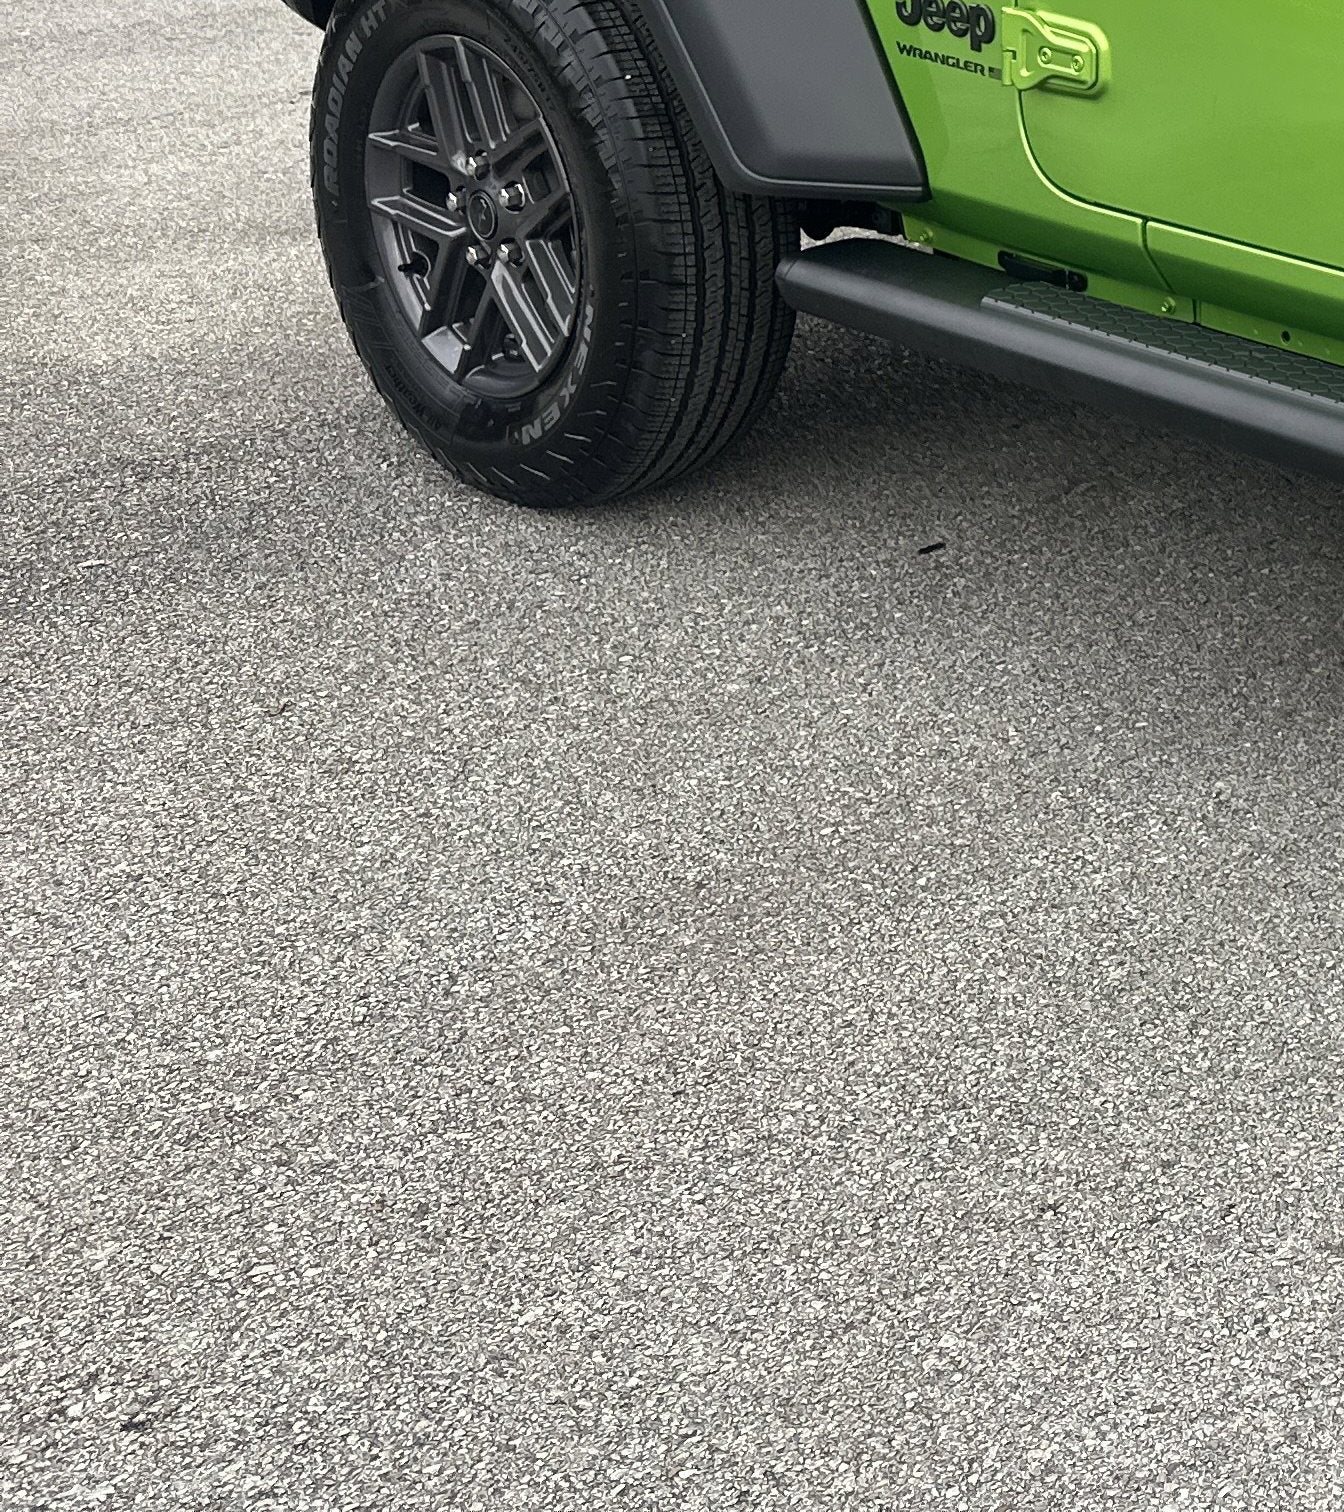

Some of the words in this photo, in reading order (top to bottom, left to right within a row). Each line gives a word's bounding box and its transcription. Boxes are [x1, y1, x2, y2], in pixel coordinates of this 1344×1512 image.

[323, 32, 364, 196] ROADIAN
[895, 40, 987, 77] WRANGLER
[520, 303, 595, 447] NEXEN
